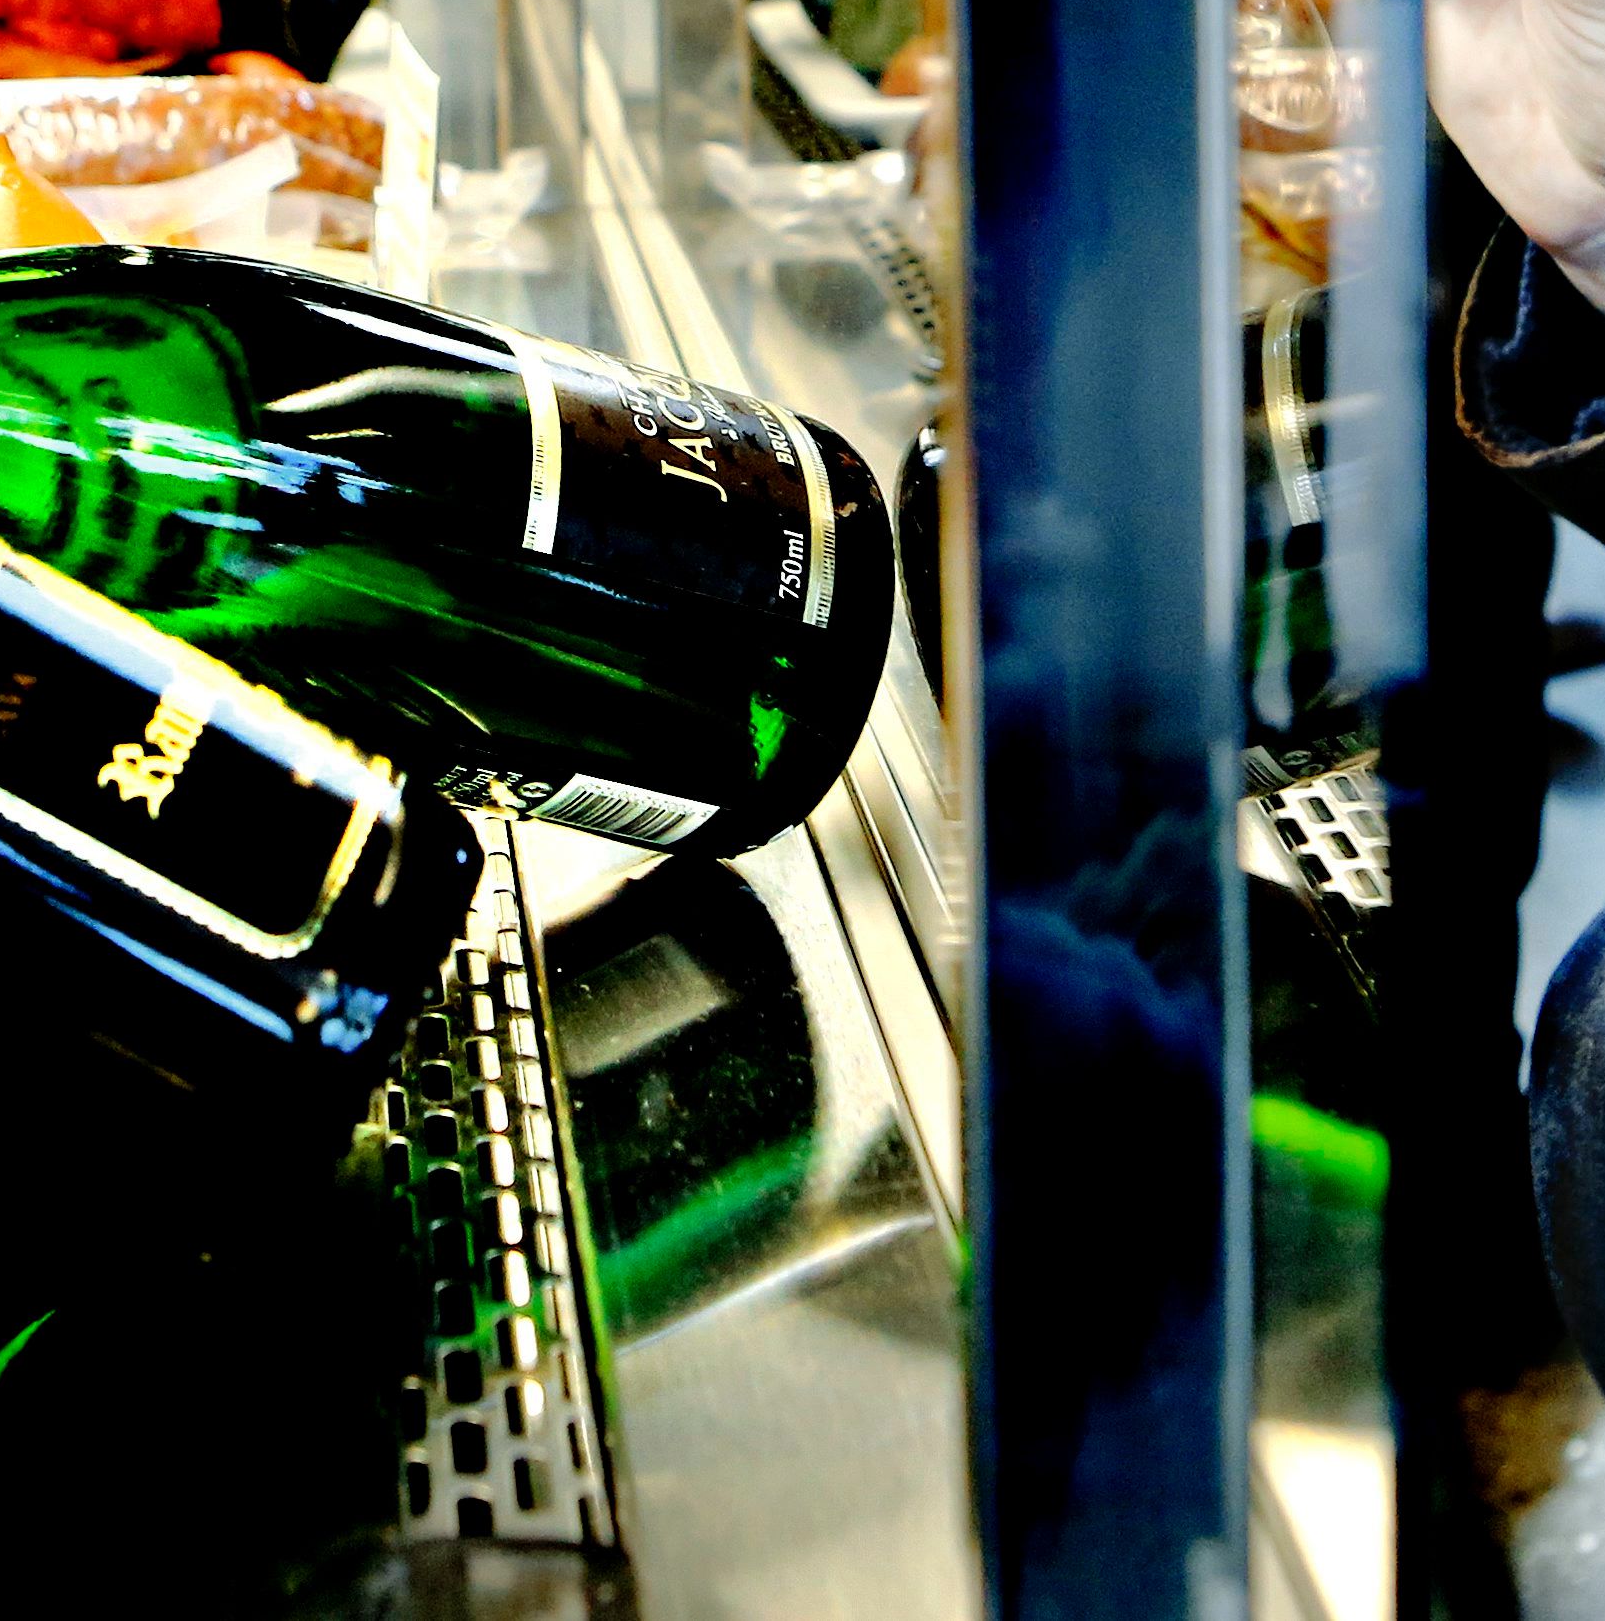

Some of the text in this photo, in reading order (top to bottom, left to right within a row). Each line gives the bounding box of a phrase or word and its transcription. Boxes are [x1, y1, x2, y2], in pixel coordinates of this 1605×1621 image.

[649, 364, 728, 503] JACQ
[759, 416, 796, 467] BRUT
[779, 529, 804, 599] 750ml
